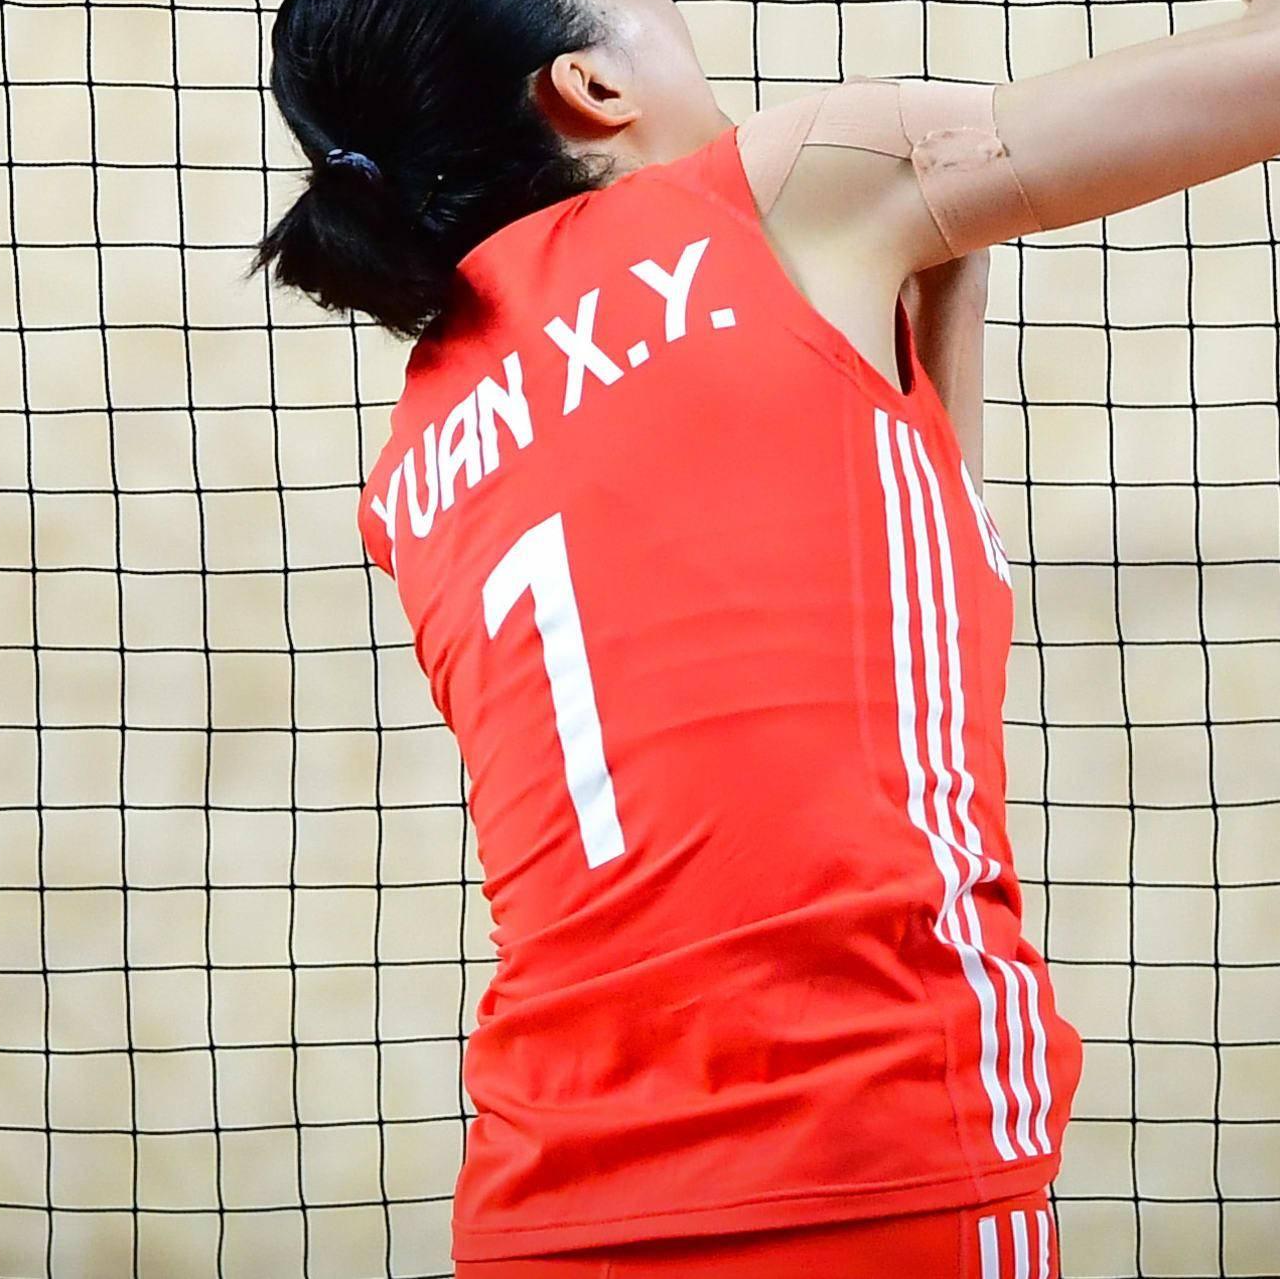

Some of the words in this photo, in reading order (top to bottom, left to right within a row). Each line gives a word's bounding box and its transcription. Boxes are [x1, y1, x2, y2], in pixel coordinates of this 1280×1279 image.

[370, 351, 534, 561] YUAN
[543, 236, 737, 416] X.Y.
[482, 512, 626, 870] 1
